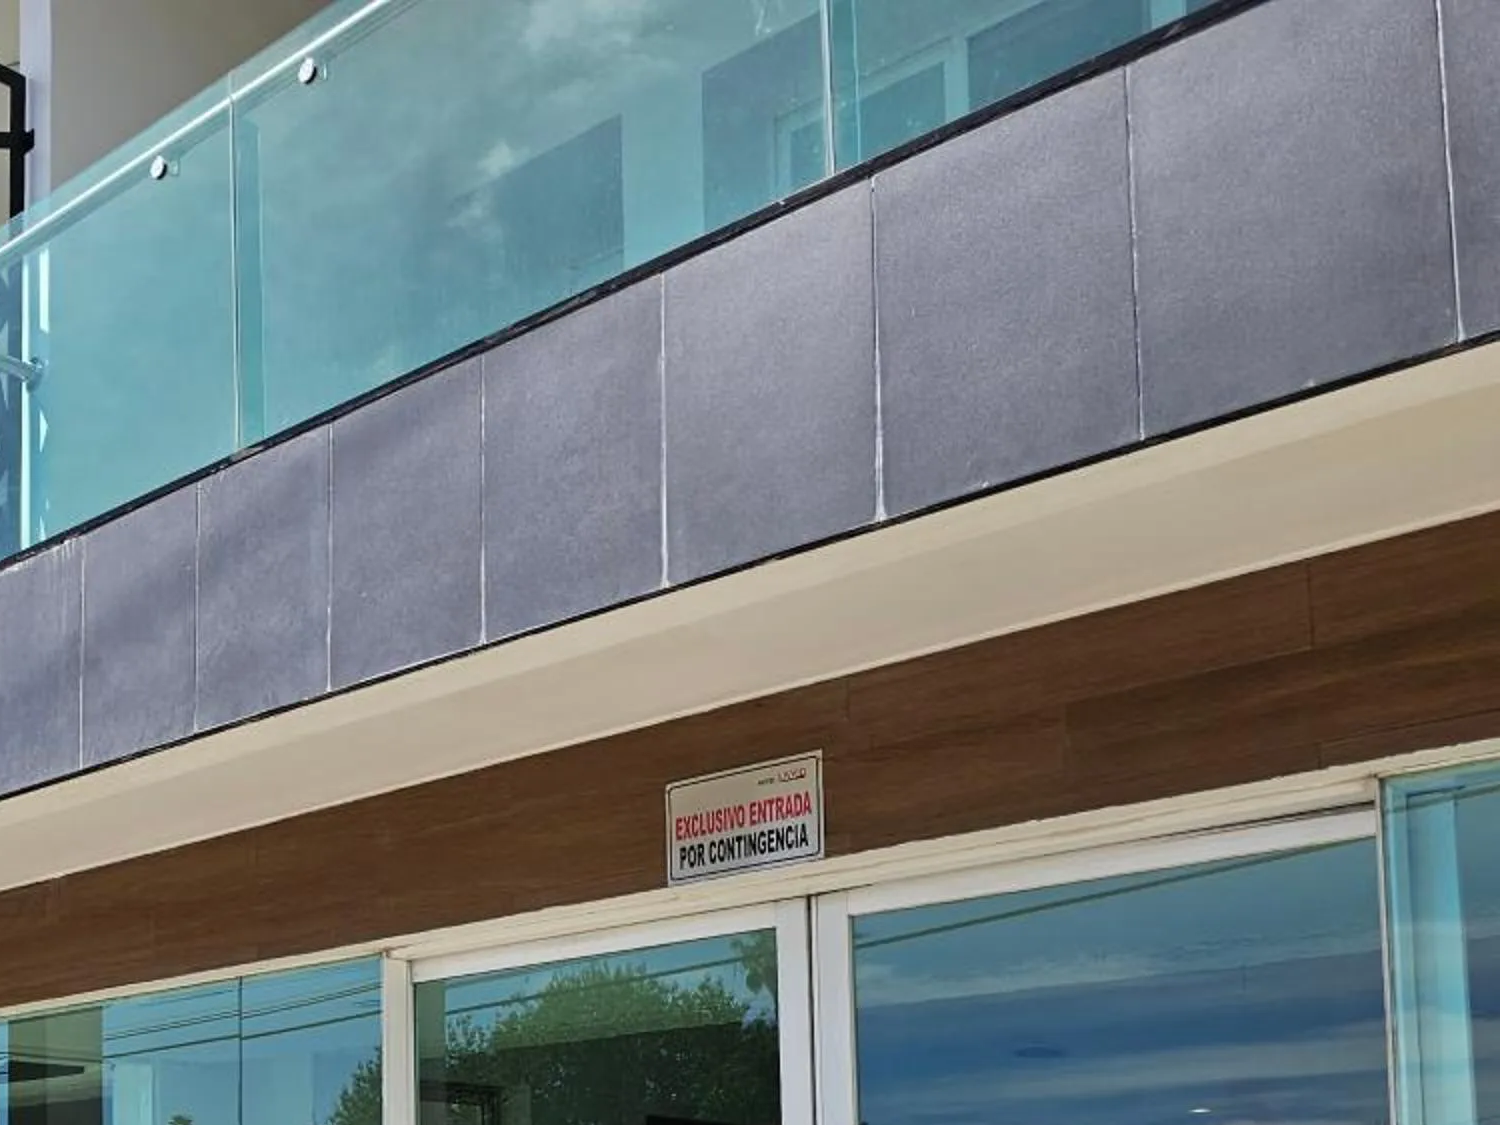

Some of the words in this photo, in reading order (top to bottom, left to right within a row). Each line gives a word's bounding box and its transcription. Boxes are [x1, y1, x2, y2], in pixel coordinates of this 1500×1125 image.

[675, 804, 745, 841] EXCLUSIVO
[749, 791, 812, 826] ENTRADA
[679, 843, 705, 870] POR
[709, 823, 809, 863] CONTINGENCIA
